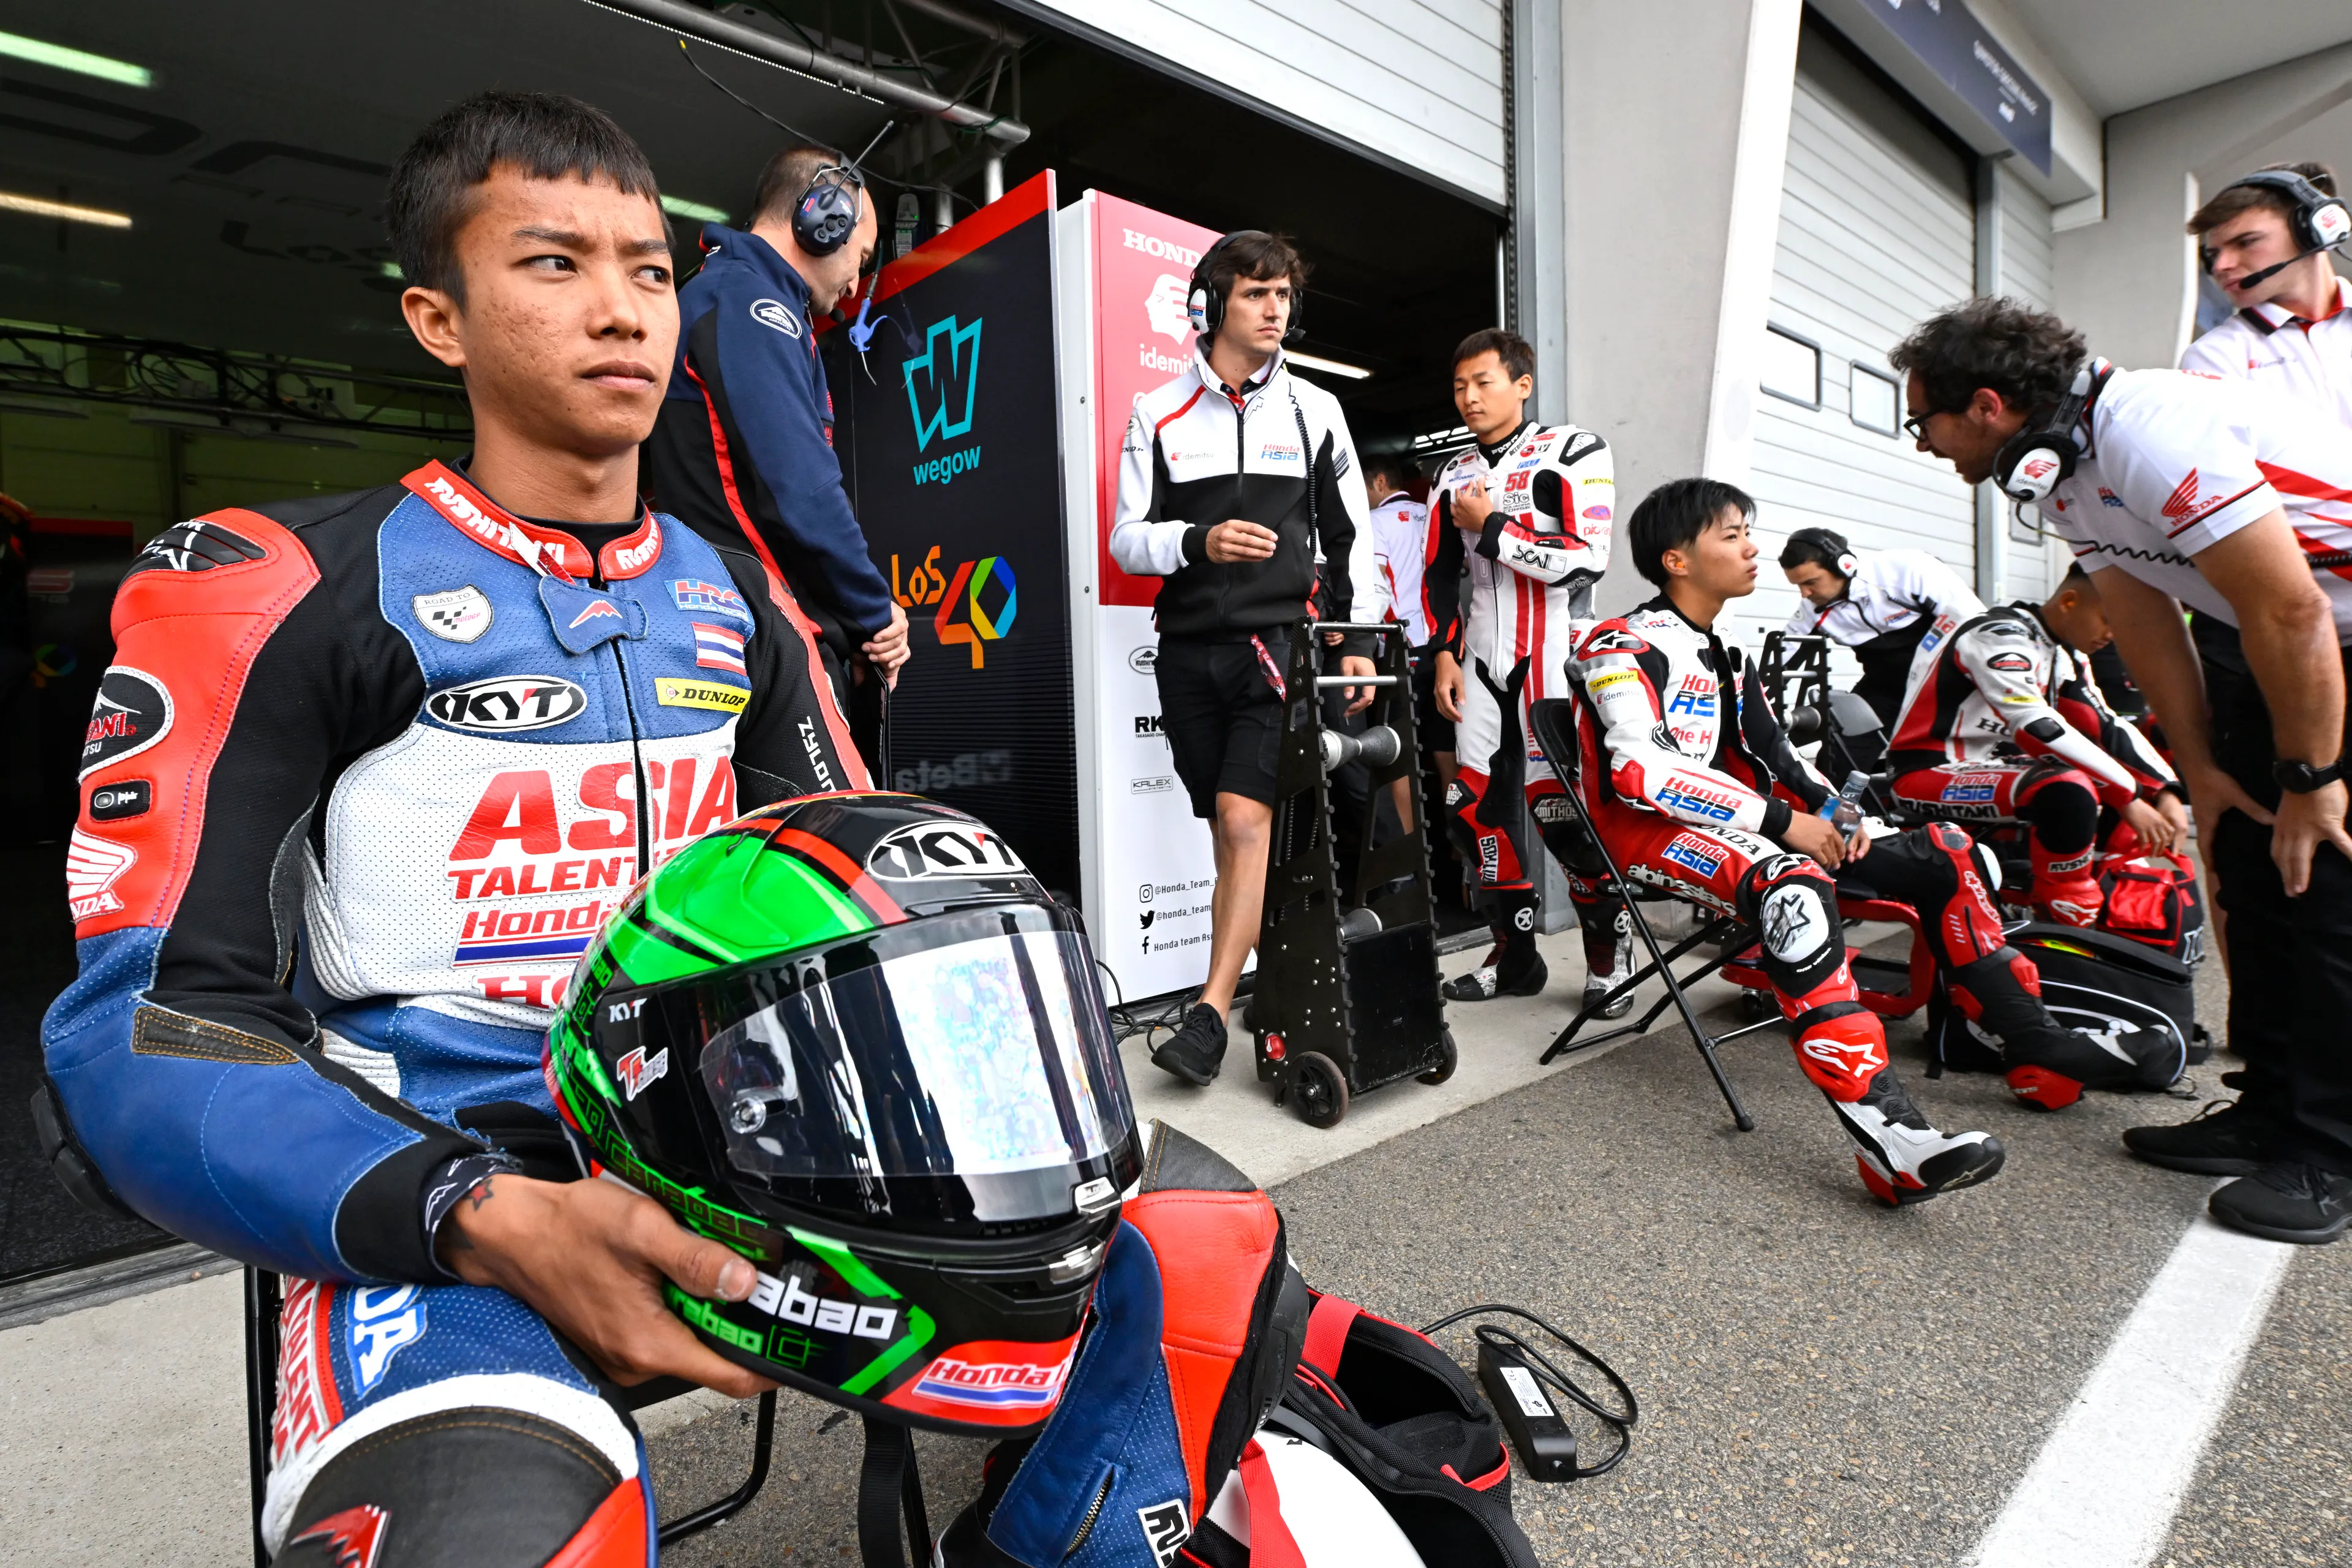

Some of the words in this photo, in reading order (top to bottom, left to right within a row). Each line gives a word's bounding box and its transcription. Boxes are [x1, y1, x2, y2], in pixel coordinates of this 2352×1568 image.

[1123, 228, 1201, 268] HOND
[1140, 344, 1194, 375] idemit
[1183, 451, 1214, 461] idemitsu
[1263, 443, 1300, 453] Honda
[913, 446, 981, 485] wegow
[1504, 469, 1531, 492] 58
[1503, 491, 1529, 506] Sic
[2171, 495, 2223, 527] HONDA
[424, 596, 454, 606] ROAD
[456, 592, 470, 601] TO
[675, 581, 747, 616] HRC
[1596, 672, 1635, 688] DUNLOP
[446, 686, 568, 723] KYT
[682, 687, 746, 706] DUNLOP
[1135, 715, 1165, 733] RK
[1133, 778, 1171, 788] KALEX
[1665, 776, 1743, 809] Honda
[447, 755, 737, 862] ASIA
[884, 831, 1016, 879] KYT
[1674, 832, 1728, 862] Honda
[69, 892, 120, 919] NDA
[1154, 941, 1178, 952] Honda
[1180, 936, 1200, 946] team
[1202, 932, 1213, 942] Asi
[608, 998, 648, 1023] KYT
[927, 1360, 1054, 1387] Honda
